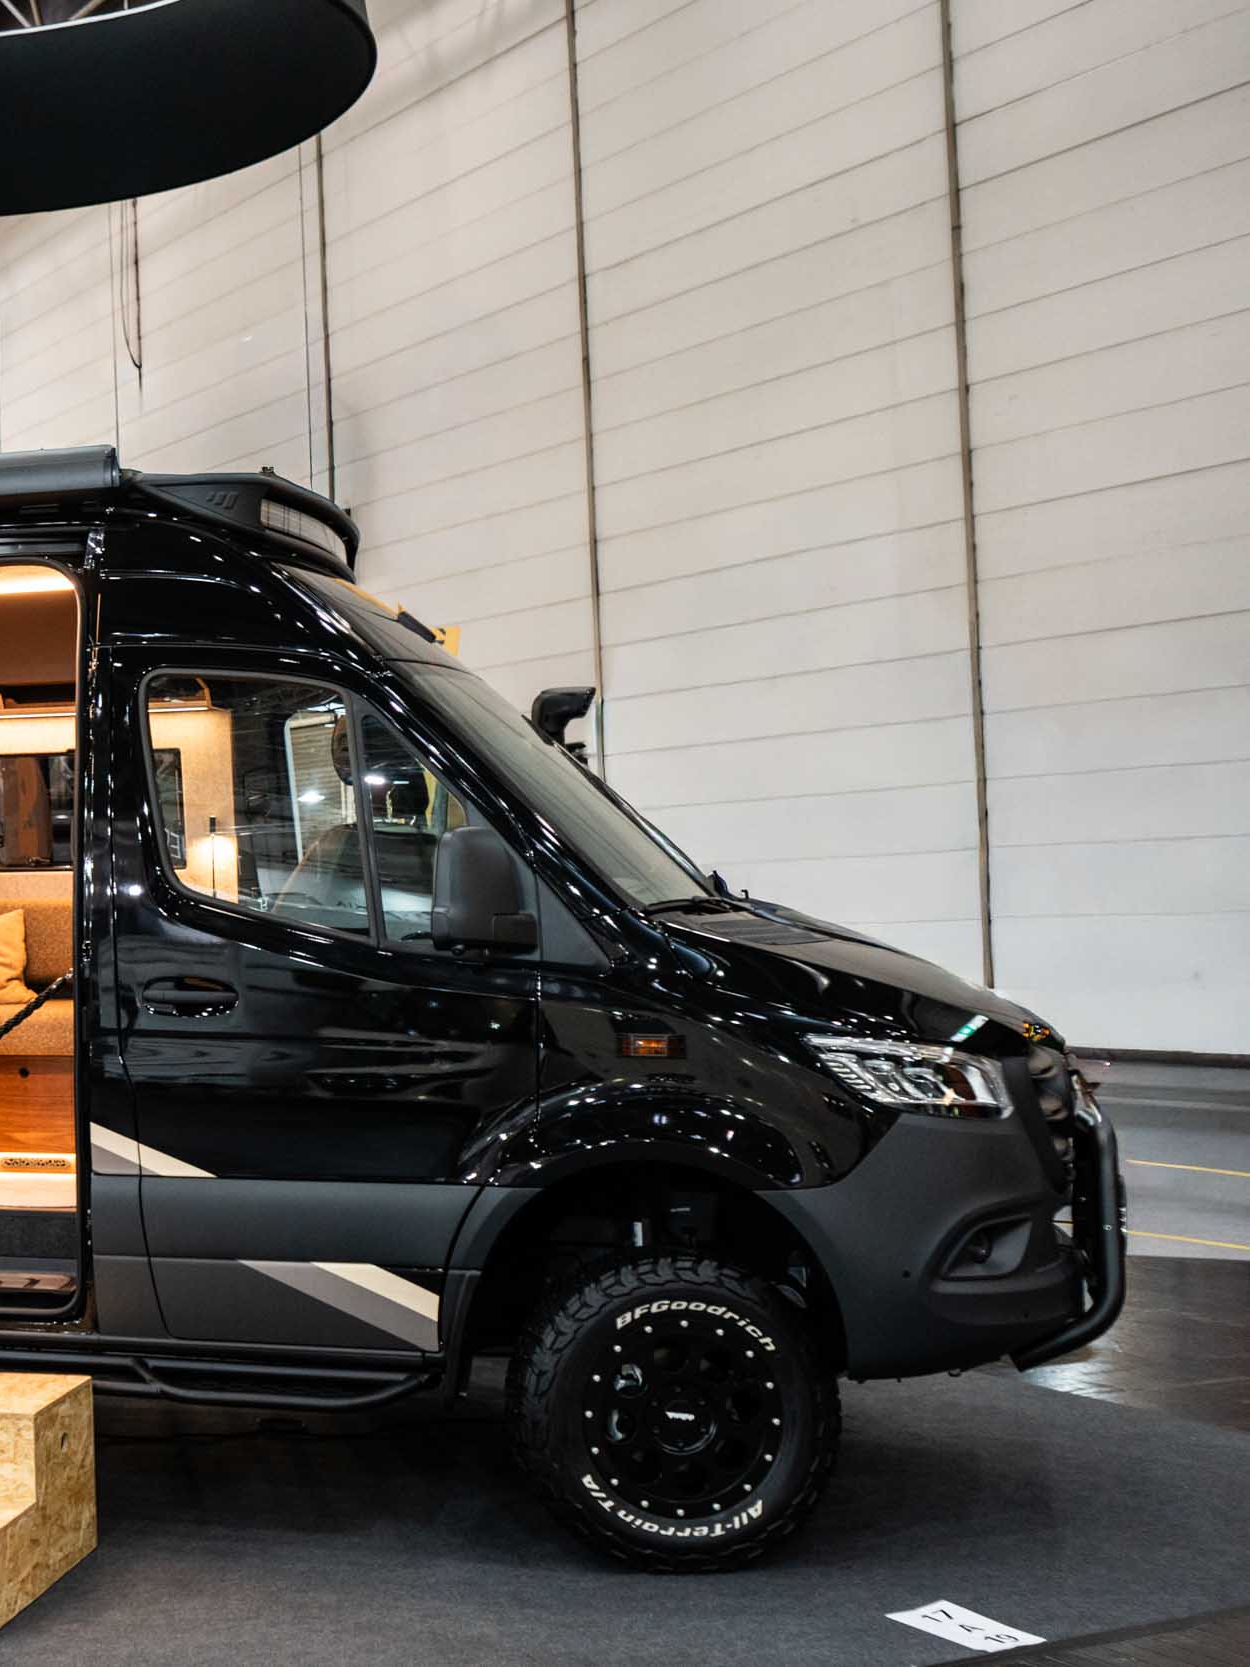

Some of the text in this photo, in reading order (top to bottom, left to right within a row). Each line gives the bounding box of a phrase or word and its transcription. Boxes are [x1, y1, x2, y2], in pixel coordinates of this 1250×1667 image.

[616, 1300, 776, 1351] BFGoodrich
[582, 1474, 763, 1537] All-Terrain T/A
[921, 1609, 954, 1623] 17
